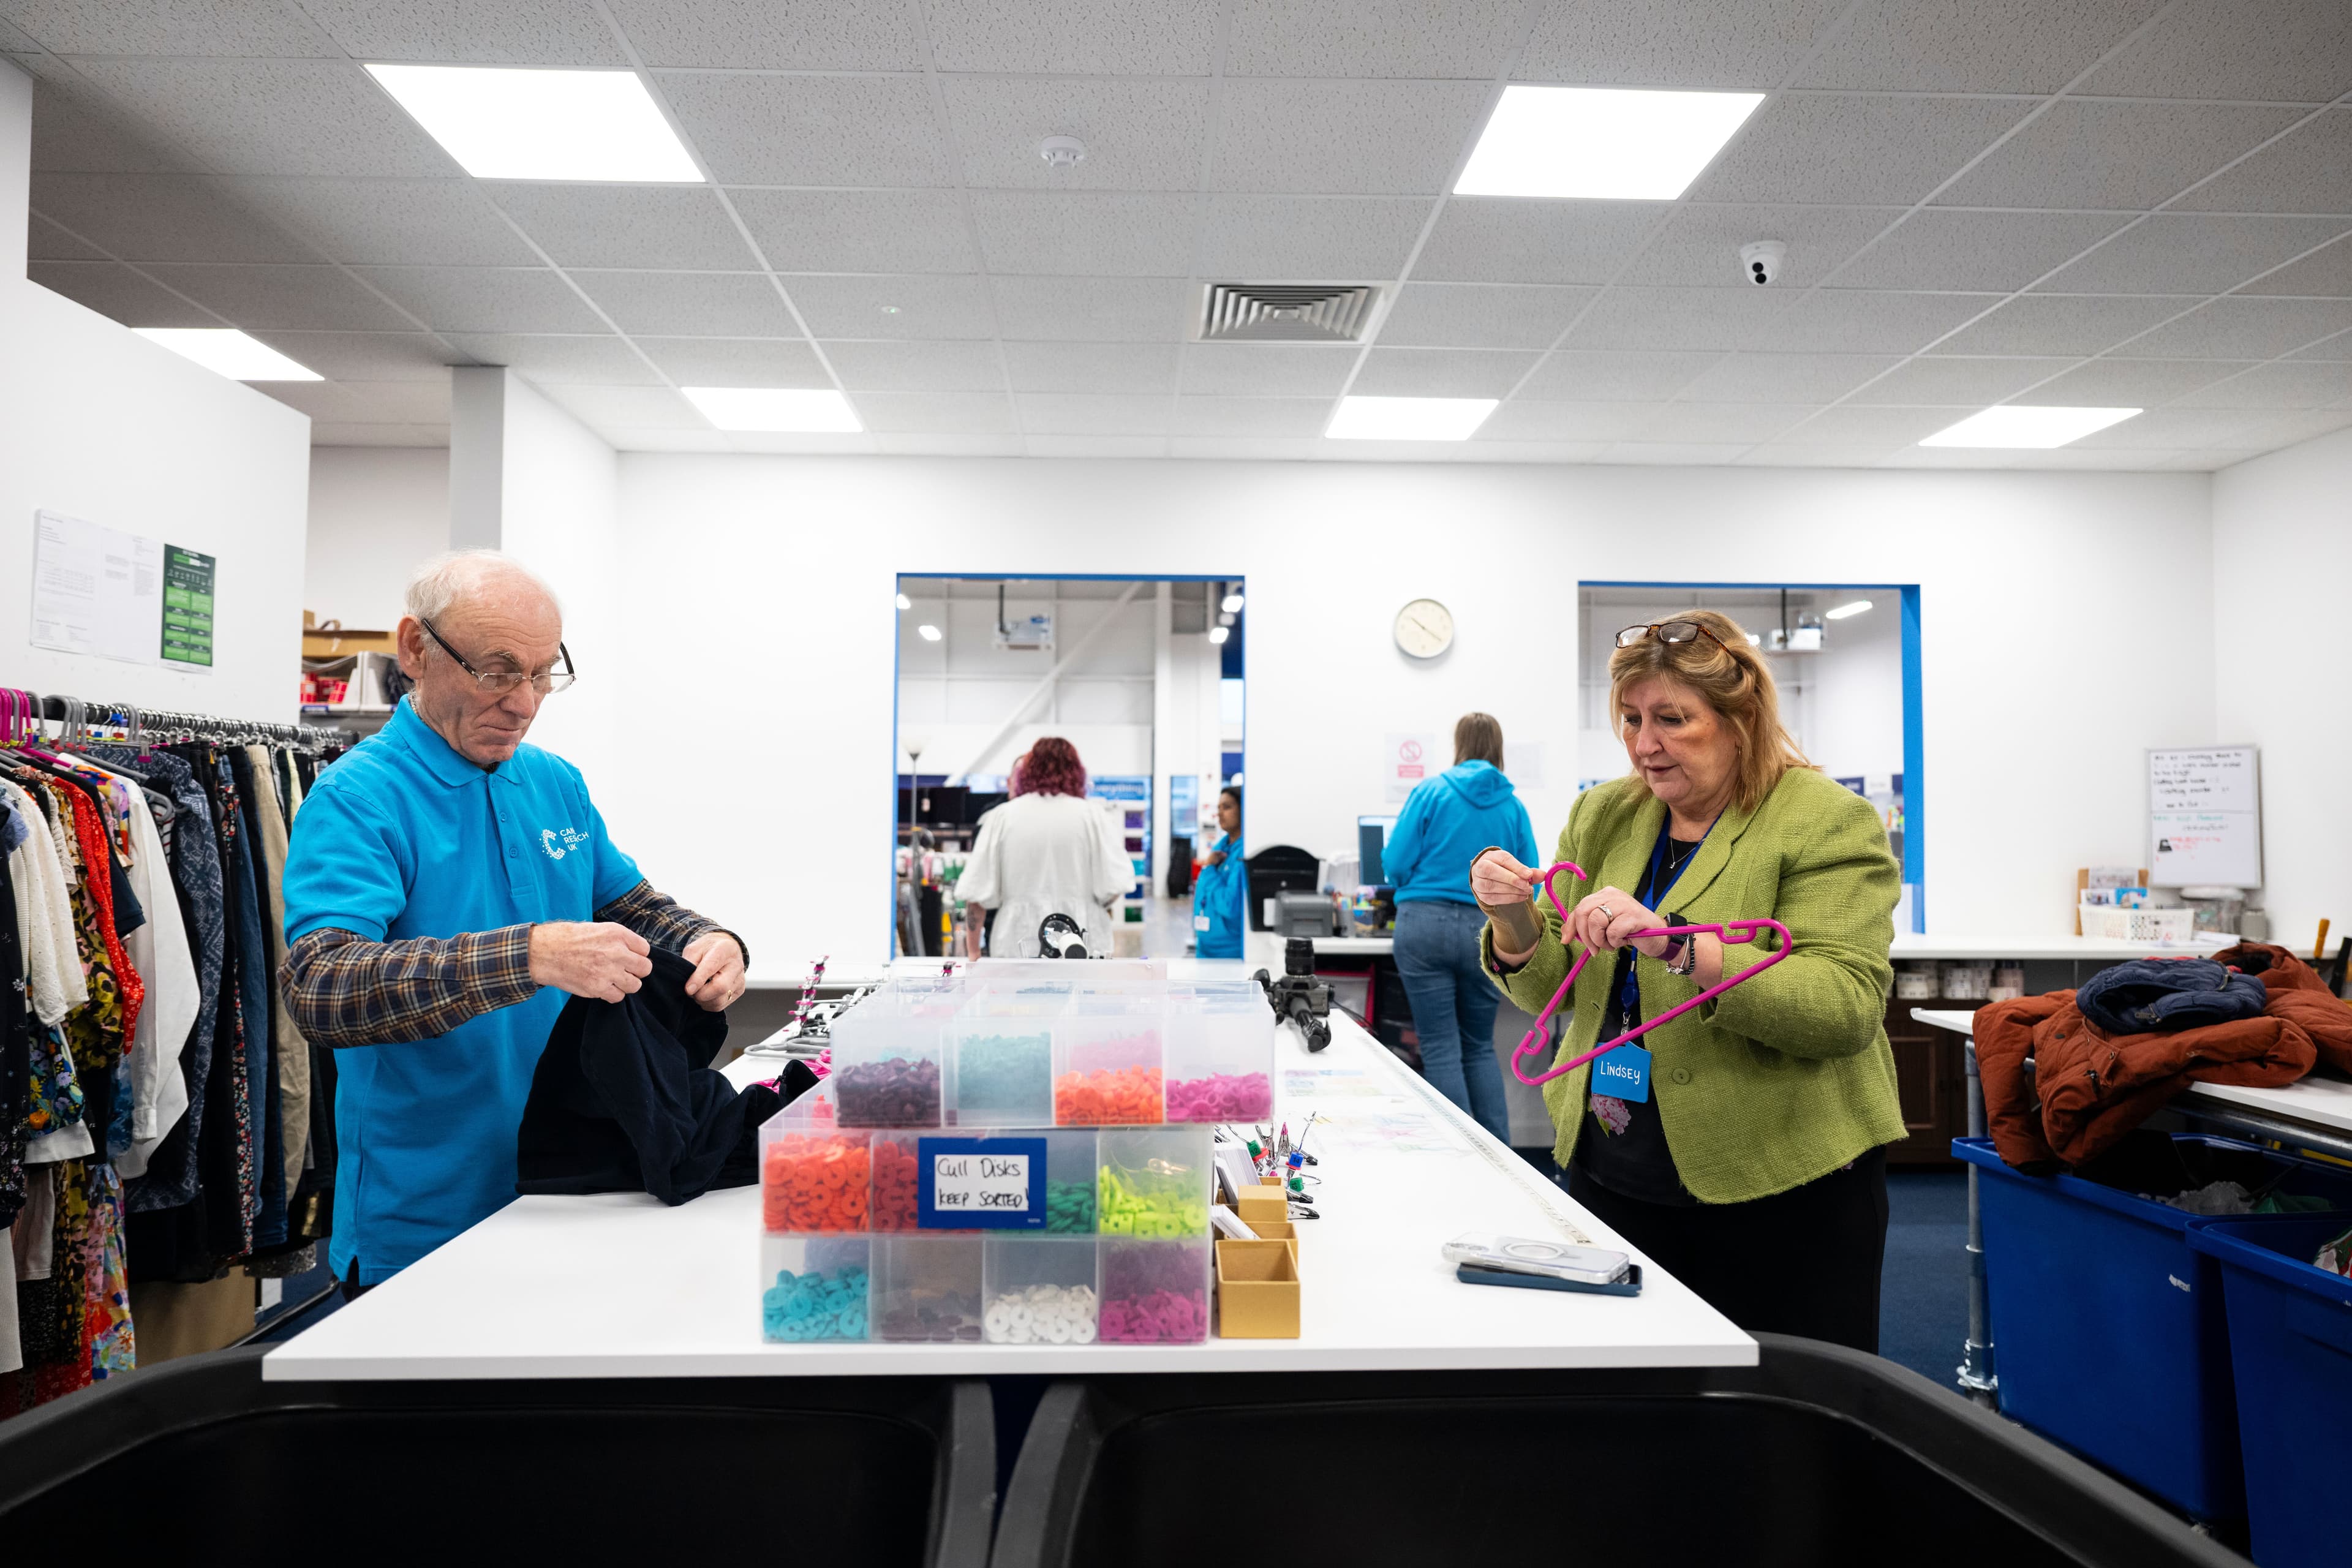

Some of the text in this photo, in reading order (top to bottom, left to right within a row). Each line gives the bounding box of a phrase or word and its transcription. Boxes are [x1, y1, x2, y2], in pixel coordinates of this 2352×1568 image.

[937, 1157, 1021, 1178] Cull Disks
[939, 1188, 970, 1207] KEEP
